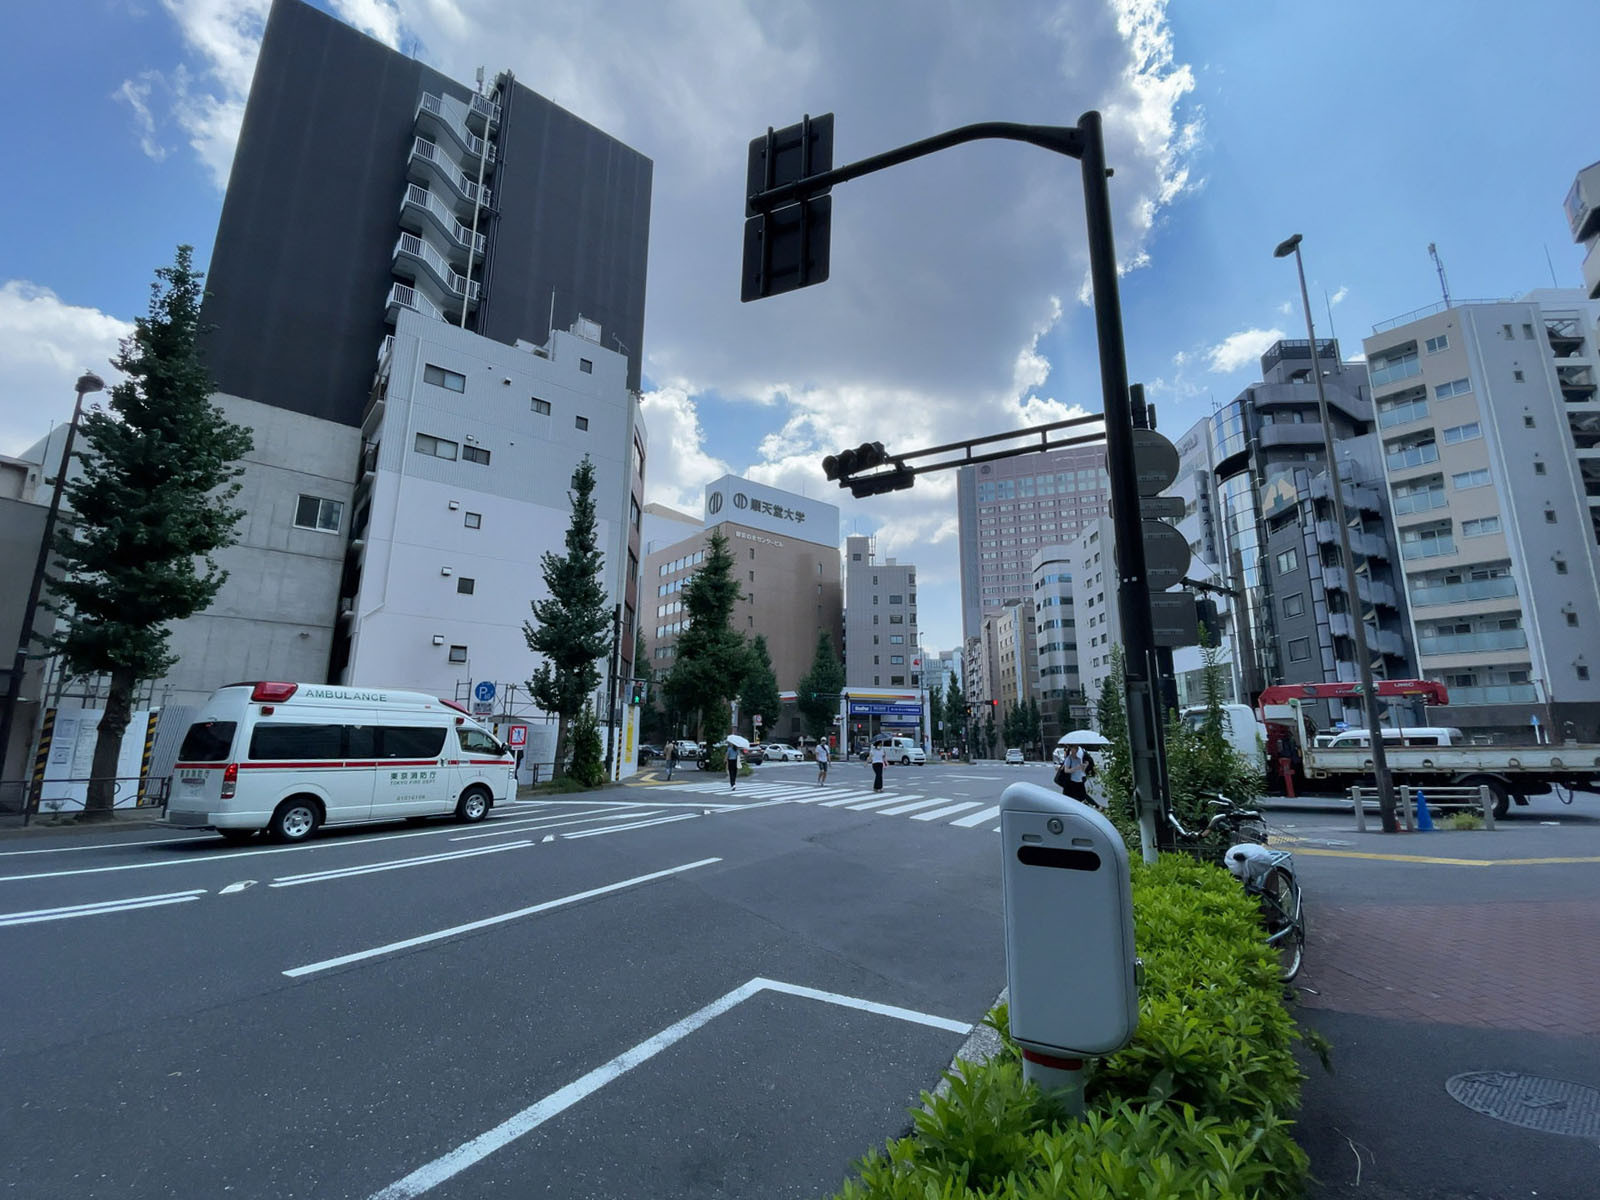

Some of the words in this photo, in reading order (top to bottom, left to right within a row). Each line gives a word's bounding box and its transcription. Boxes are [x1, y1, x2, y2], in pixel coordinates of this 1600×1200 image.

[750, 498, 805, 523] 順天堂大学
[305, 689, 387, 702] AMBULANCE
[479, 686, 488, 699] P
[390, 771, 436, 780] 東京消防庁
